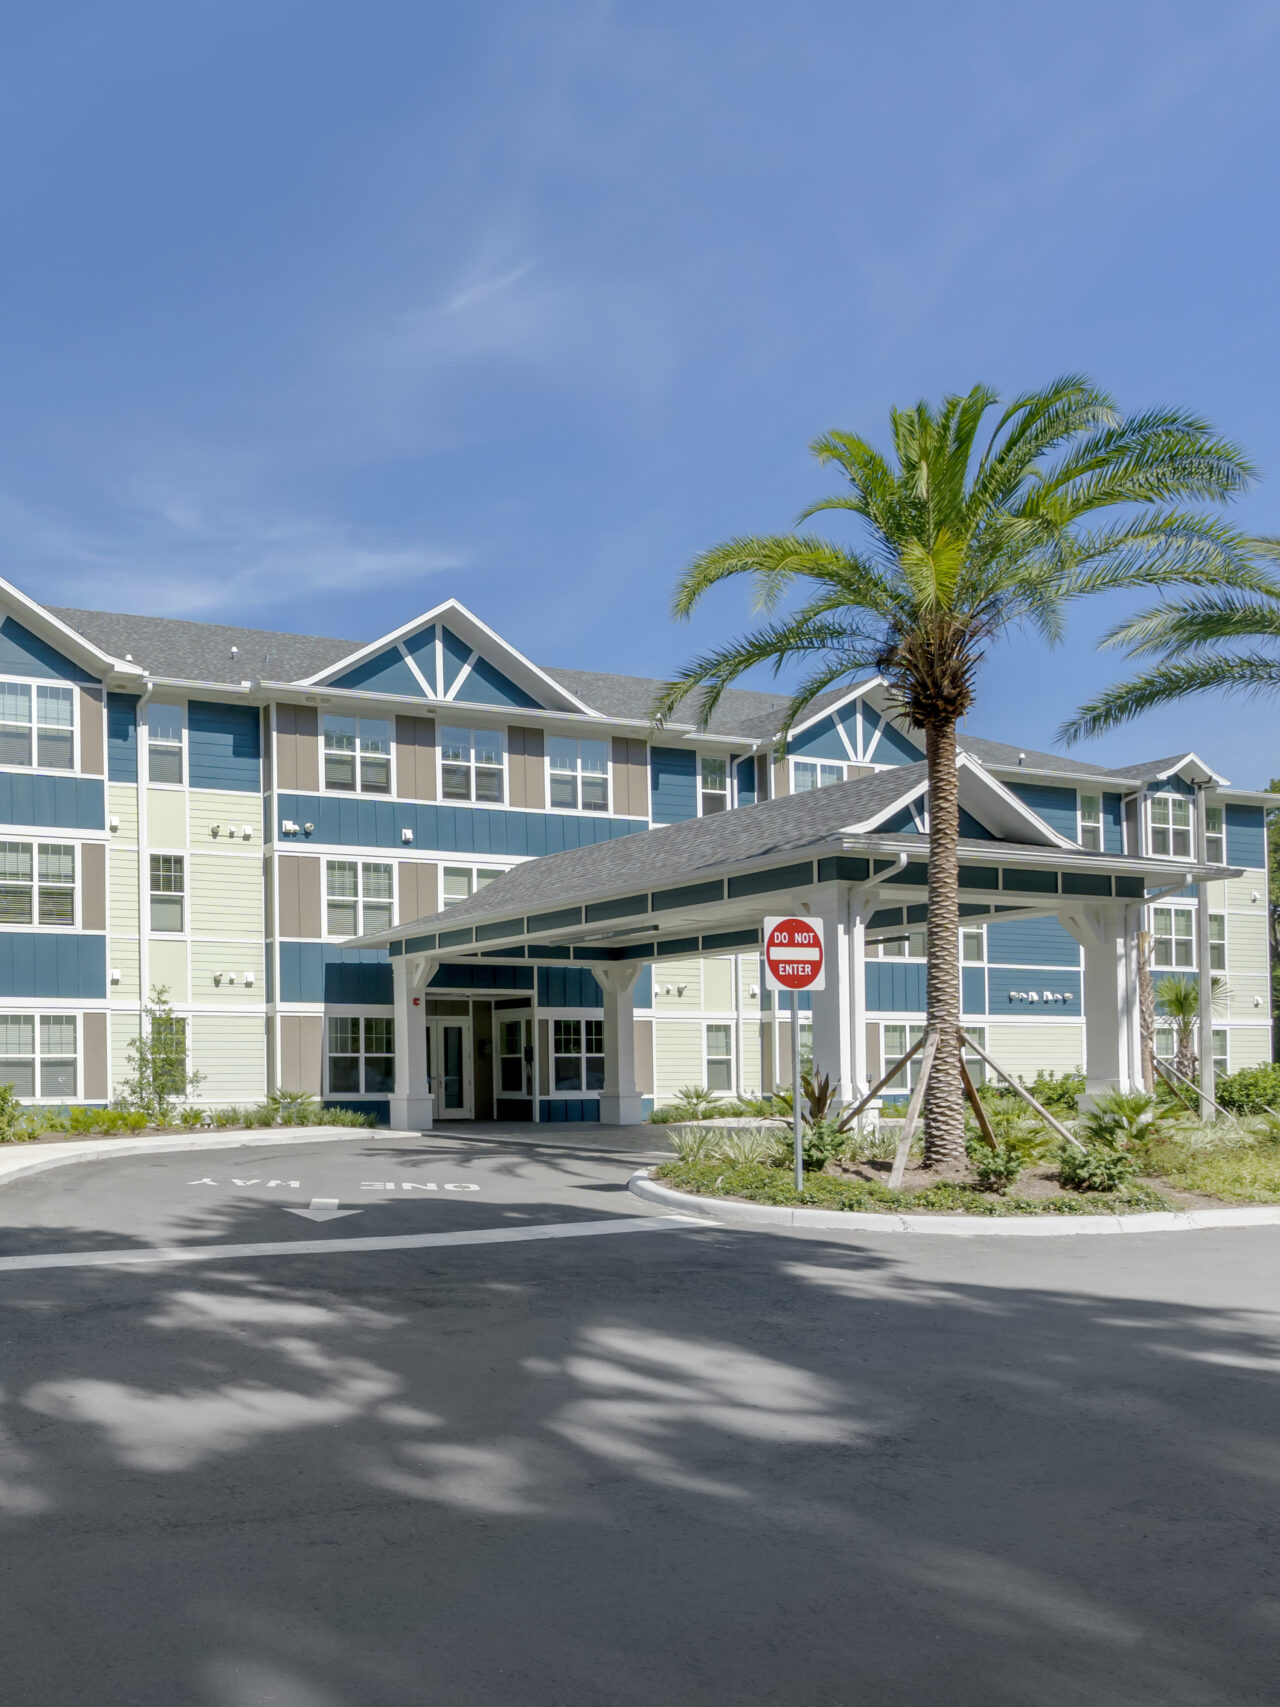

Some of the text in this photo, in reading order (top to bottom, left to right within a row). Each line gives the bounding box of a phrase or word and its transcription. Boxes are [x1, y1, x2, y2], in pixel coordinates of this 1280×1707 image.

[774, 932, 815, 944] DO NOT
[779, 964, 812, 975] ENTER
[185, 1178, 480, 1190] ONE WAY
